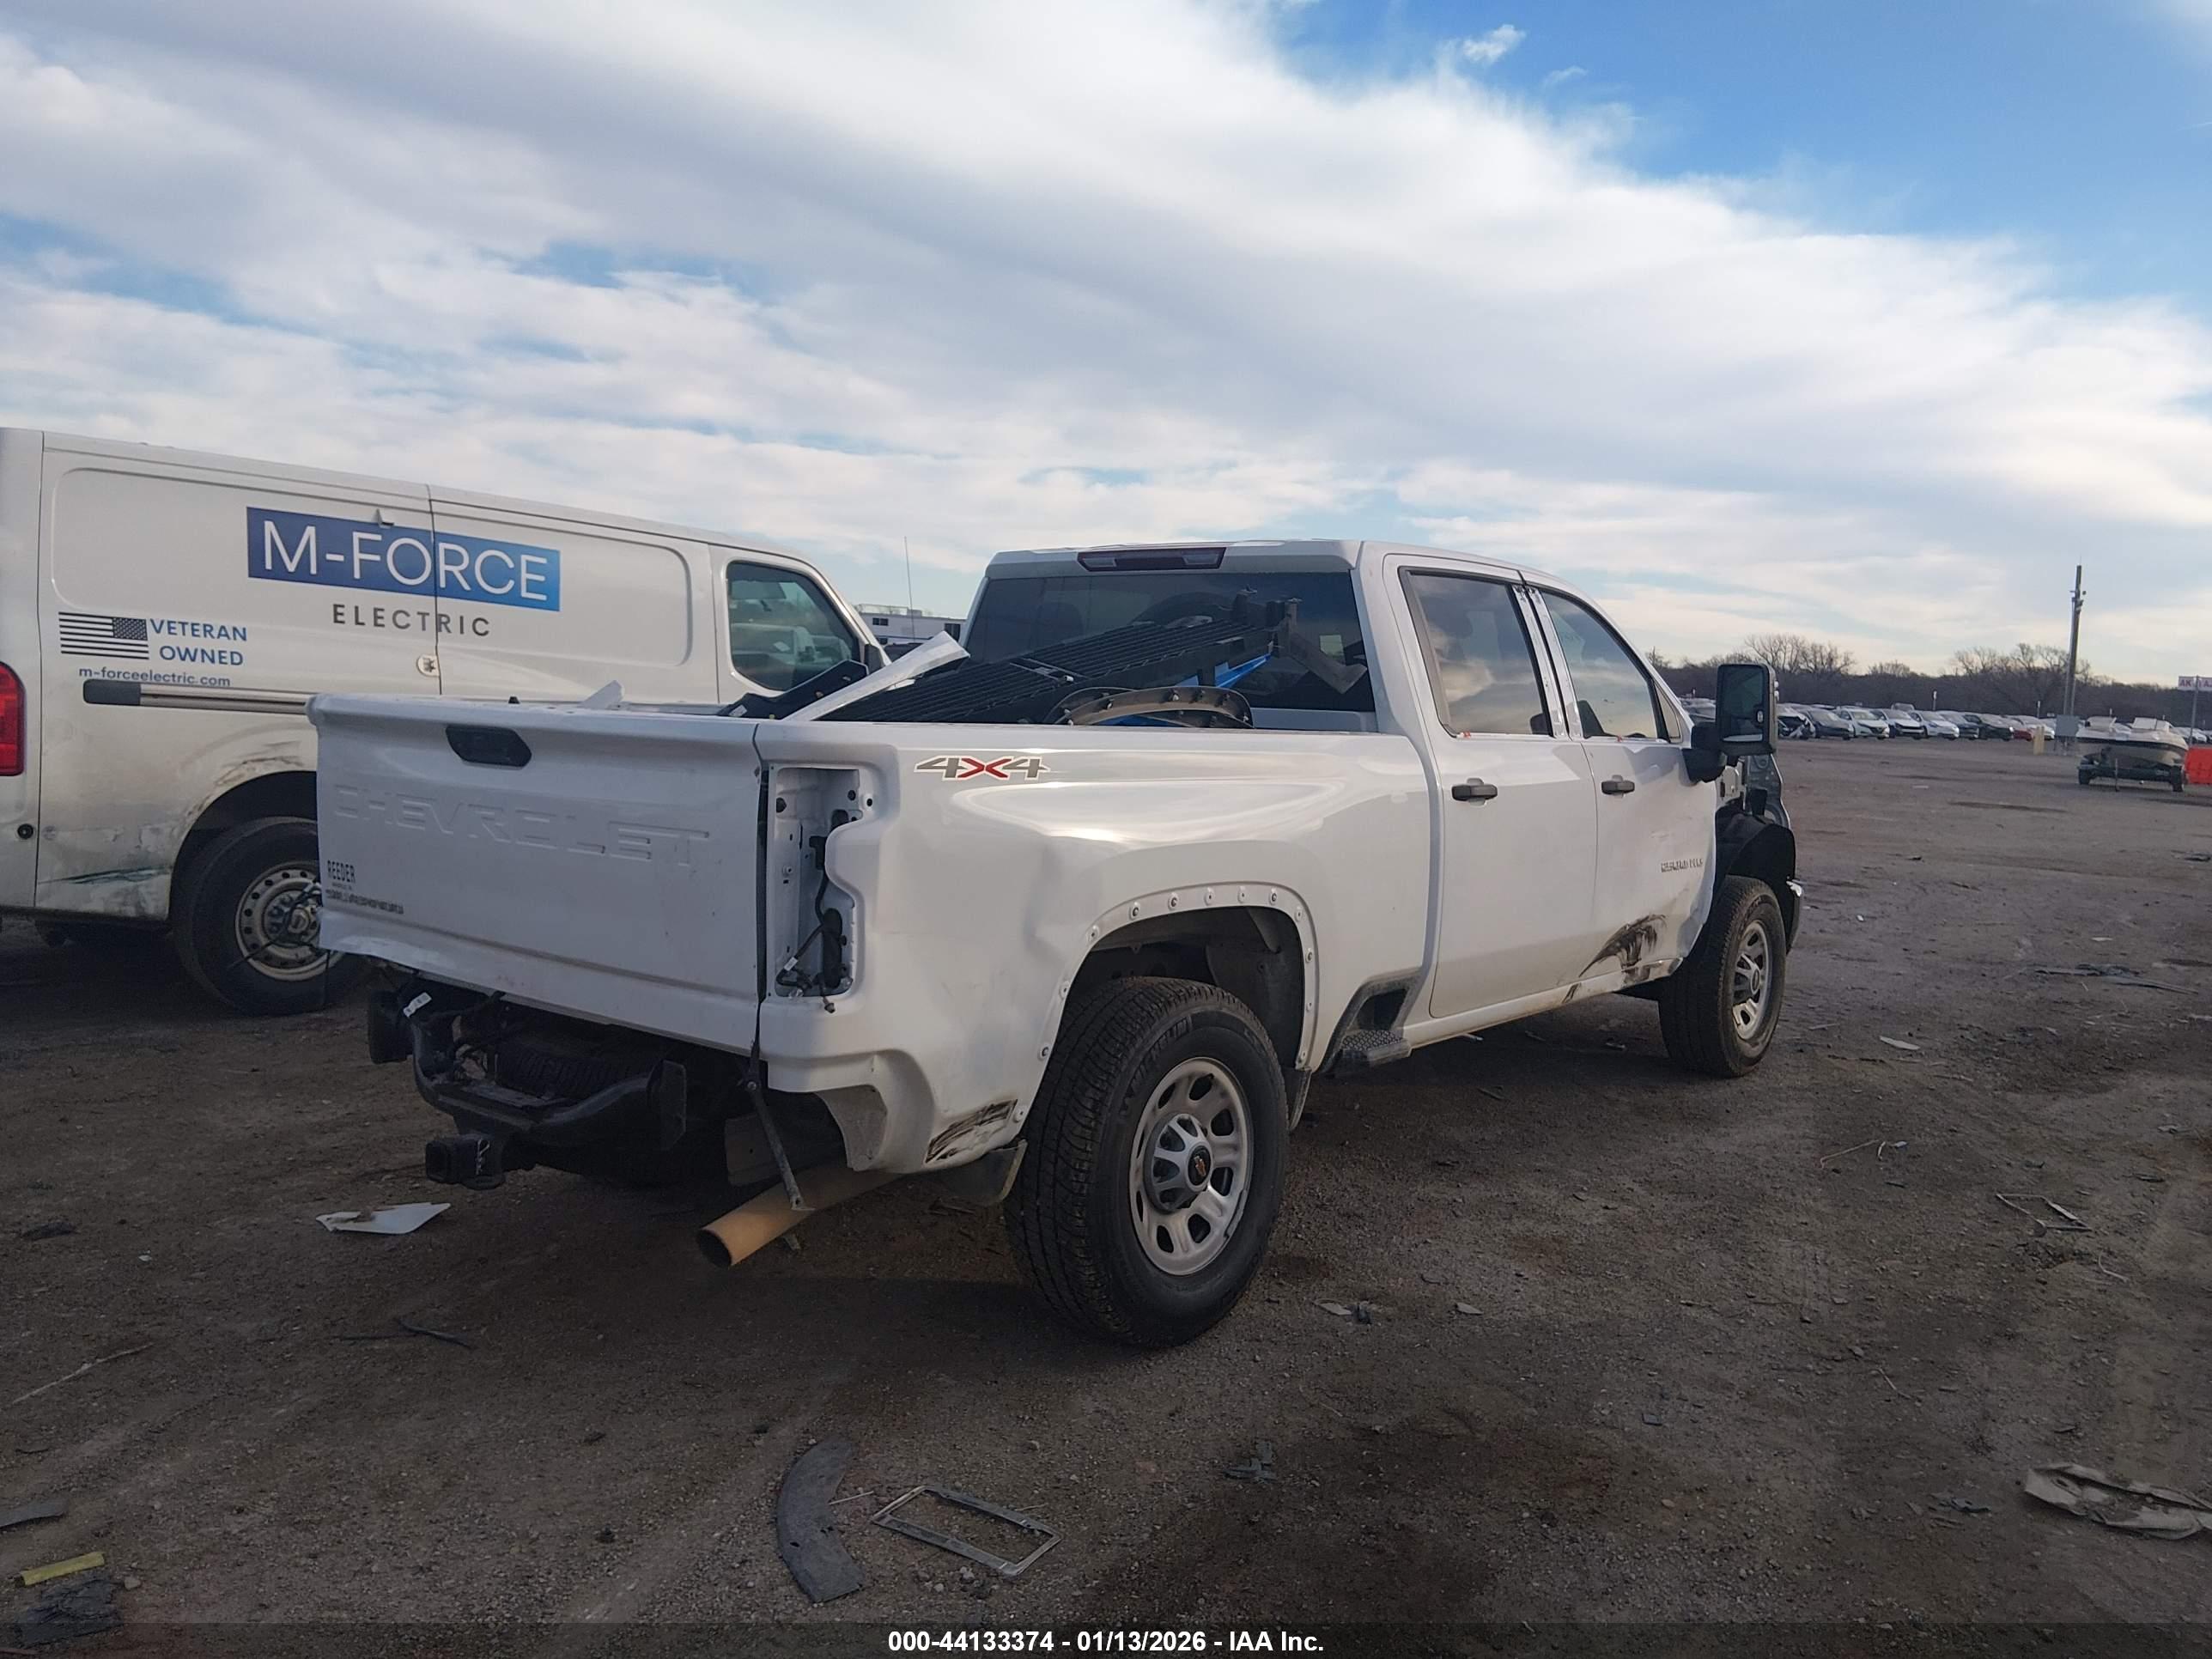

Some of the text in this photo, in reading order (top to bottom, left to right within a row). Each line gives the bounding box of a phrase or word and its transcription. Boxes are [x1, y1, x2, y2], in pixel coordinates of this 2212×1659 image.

[264, 520, 548, 601] M-FORCE
[149, 618, 247, 641] VETERAN
[332, 603, 490, 636] ELECTRIC
[159, 645, 244, 665] OWNED
[79, 666, 231, 687] m-forceelectric.com
[333, 783, 710, 866] CHEVROLET
[327, 860, 356, 883] REEDER
